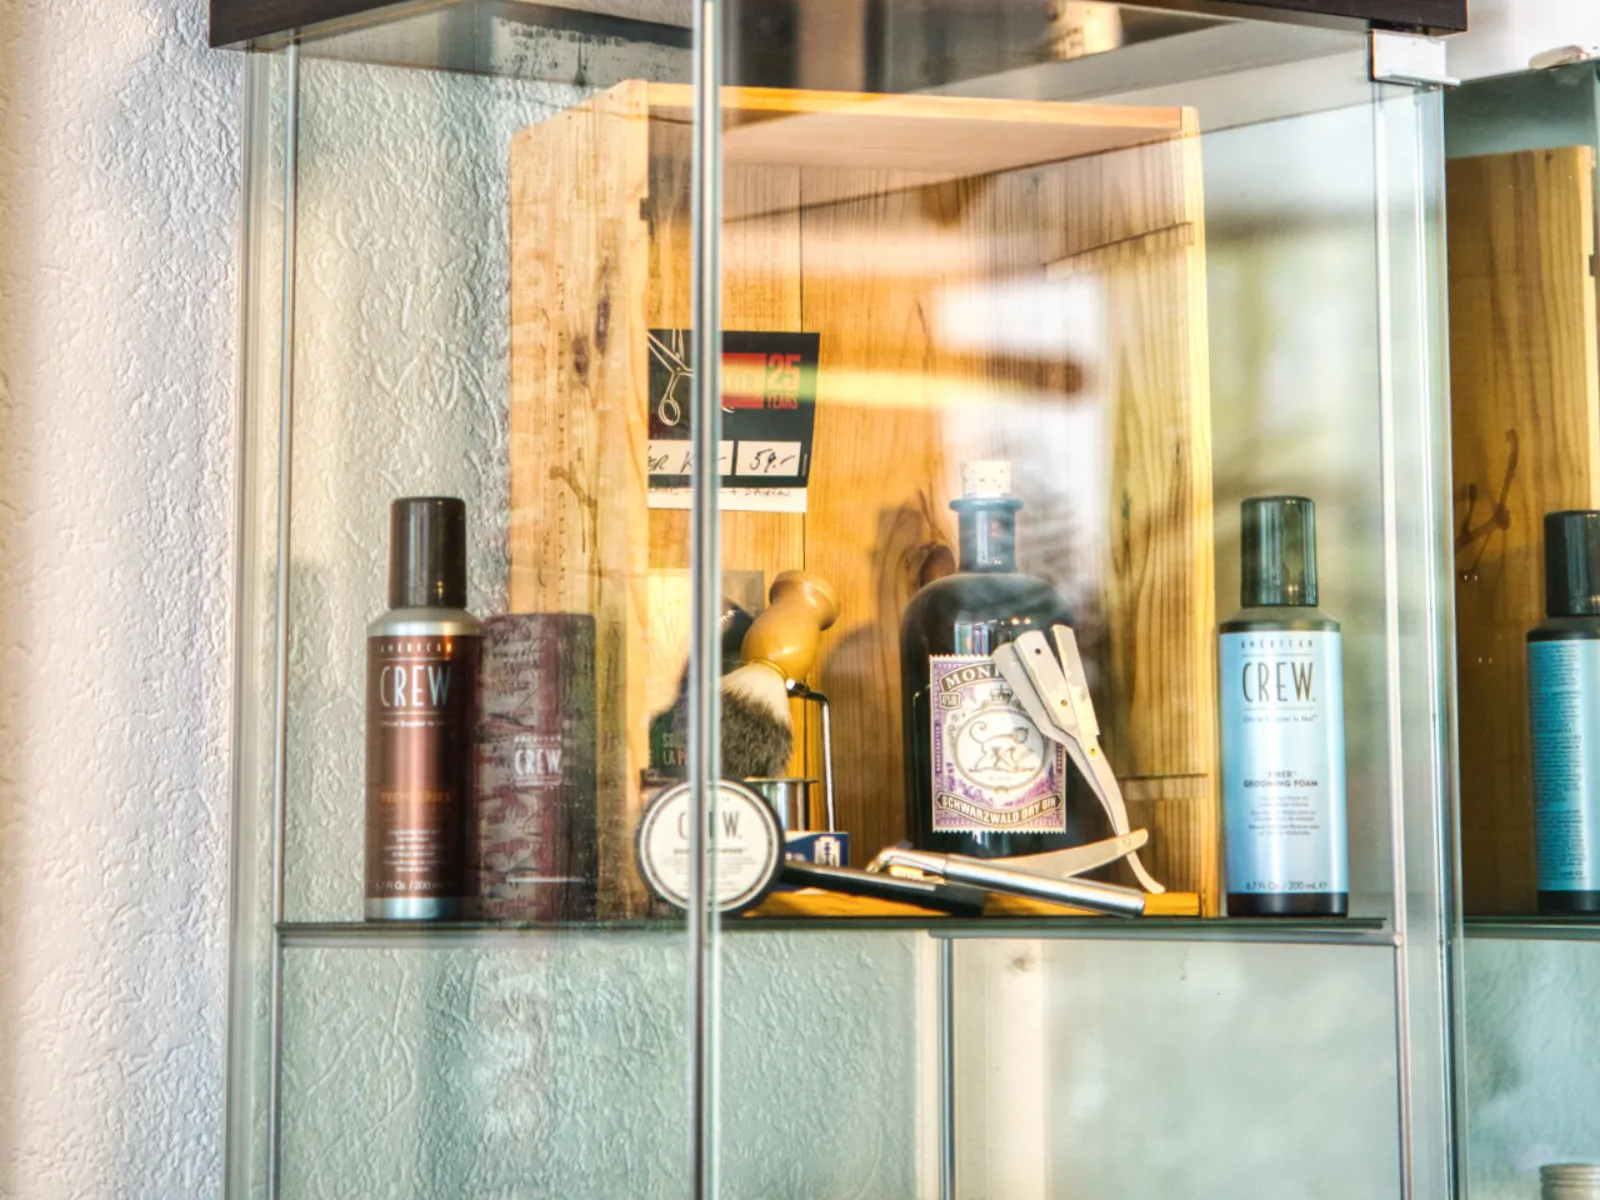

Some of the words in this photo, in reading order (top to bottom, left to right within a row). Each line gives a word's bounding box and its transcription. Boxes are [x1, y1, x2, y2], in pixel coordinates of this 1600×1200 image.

[767, 353, 801, 391] 25
[767, 390, 798, 410] YEARS
[380, 664, 451, 708] CREW
[1294, 779, 1318, 788] FOAM
[941, 795, 1020, 825] SCHWARZWALD
[1021, 803, 1042, 821] DRY
[1042, 797, 1057, 811] GIN
